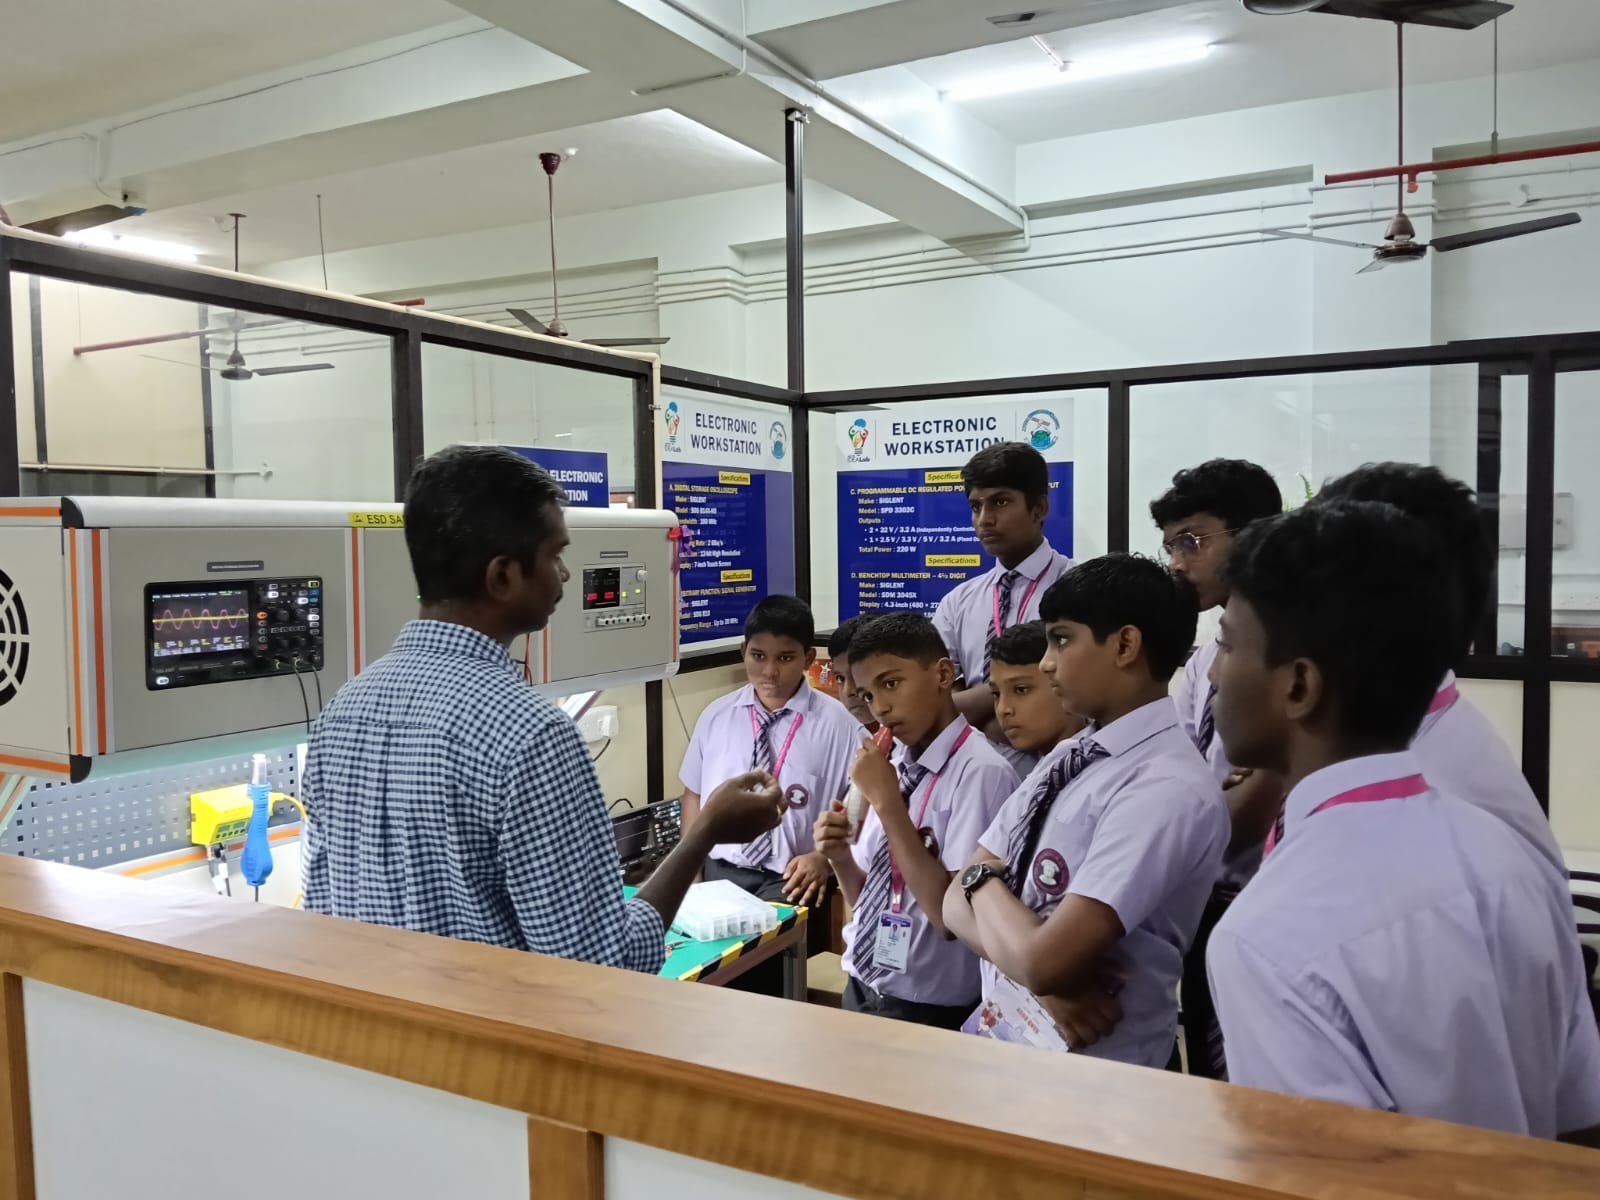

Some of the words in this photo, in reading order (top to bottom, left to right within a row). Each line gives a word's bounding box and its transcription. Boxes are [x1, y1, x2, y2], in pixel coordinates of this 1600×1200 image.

[695, 412, 757, 435] ELECTRONIC
[892, 416, 997, 436] ELECTRONIC
[690, 434, 762, 456] WORKSTATION
[927, 473, 964, 481] Specifica
[857, 487, 907, 495] PROGRAMMABLE
[908, 486, 918, 494] DC
[918, 485, 953, 493] REGULATED
[564, 489, 588, 502] TION
[858, 497, 875, 505] Make
[878, 496, 905, 504] SIGLENT
[880, 506, 894, 514] SPD
[366, 514, 387, 525] ESD
[858, 517, 881, 525] Outputs
[927, 556, 977, 565] Specifications
[881, 591, 896, 599] SDM
[859, 601, 880, 609] Display
